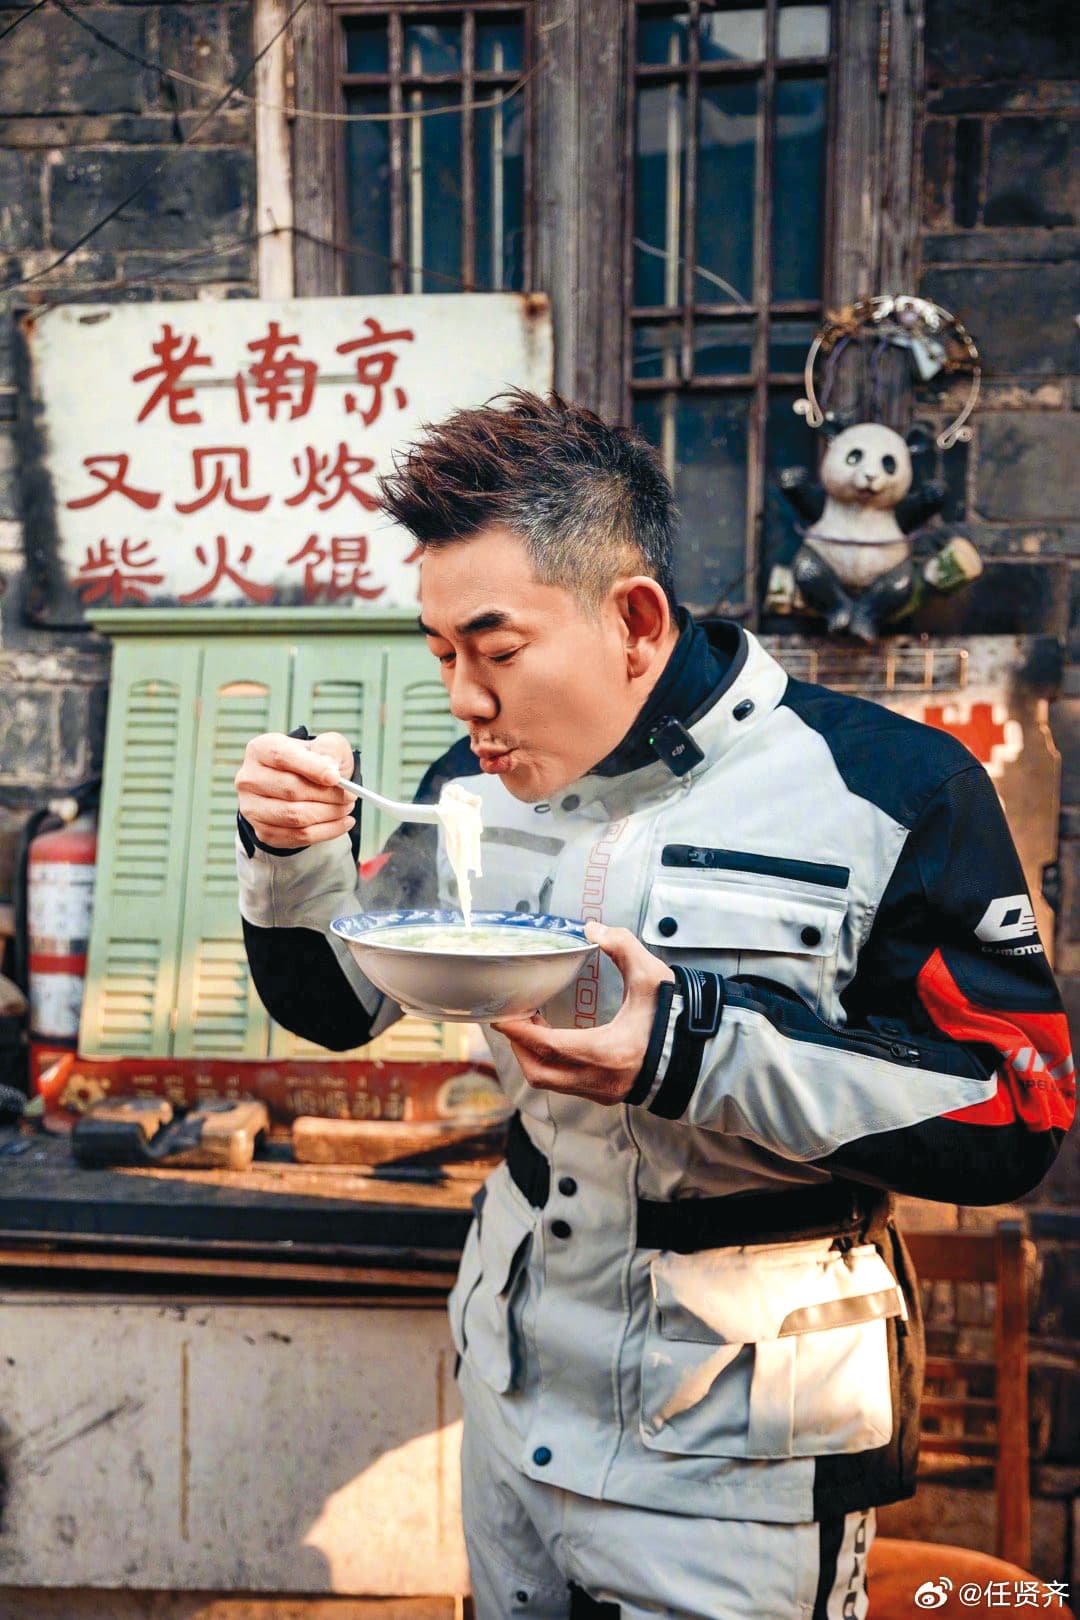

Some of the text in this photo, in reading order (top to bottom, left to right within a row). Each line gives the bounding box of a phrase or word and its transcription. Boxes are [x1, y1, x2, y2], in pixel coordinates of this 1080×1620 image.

[132, 316, 415, 427] 老南京
[66, 441, 383, 515] 又见炊
[70, 534, 425, 605] 柴火馄
